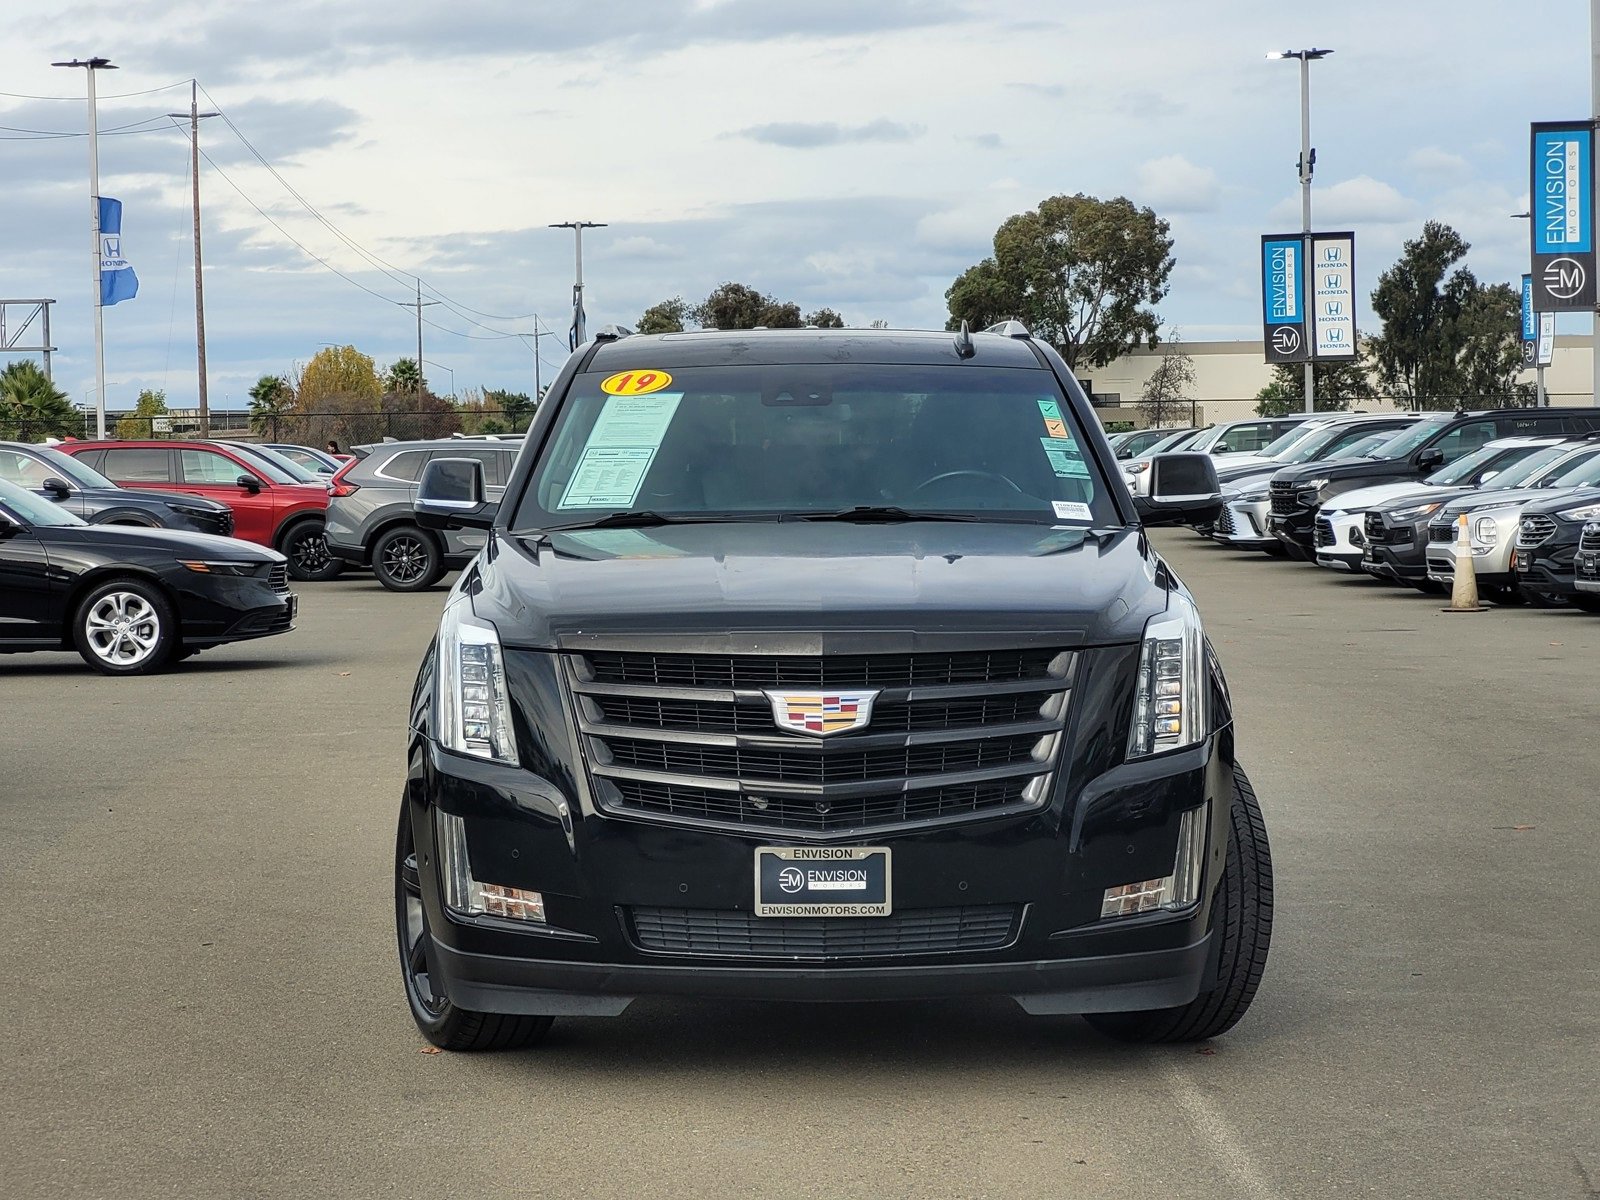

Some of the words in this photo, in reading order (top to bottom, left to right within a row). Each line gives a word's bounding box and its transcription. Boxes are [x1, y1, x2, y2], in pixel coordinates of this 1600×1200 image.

[1546, 141, 1565, 244] ENVISION
[1569, 151, 1577, 234] MOTORS
[1272, 247, 1286, 318] ENVISION
[615, 373, 658, 392] 19
[793, 849, 853, 859] ENVISION
[807, 870, 867, 881] ENVISION
[761, 906, 885, 915] ENVISIONMOTORS.COM
